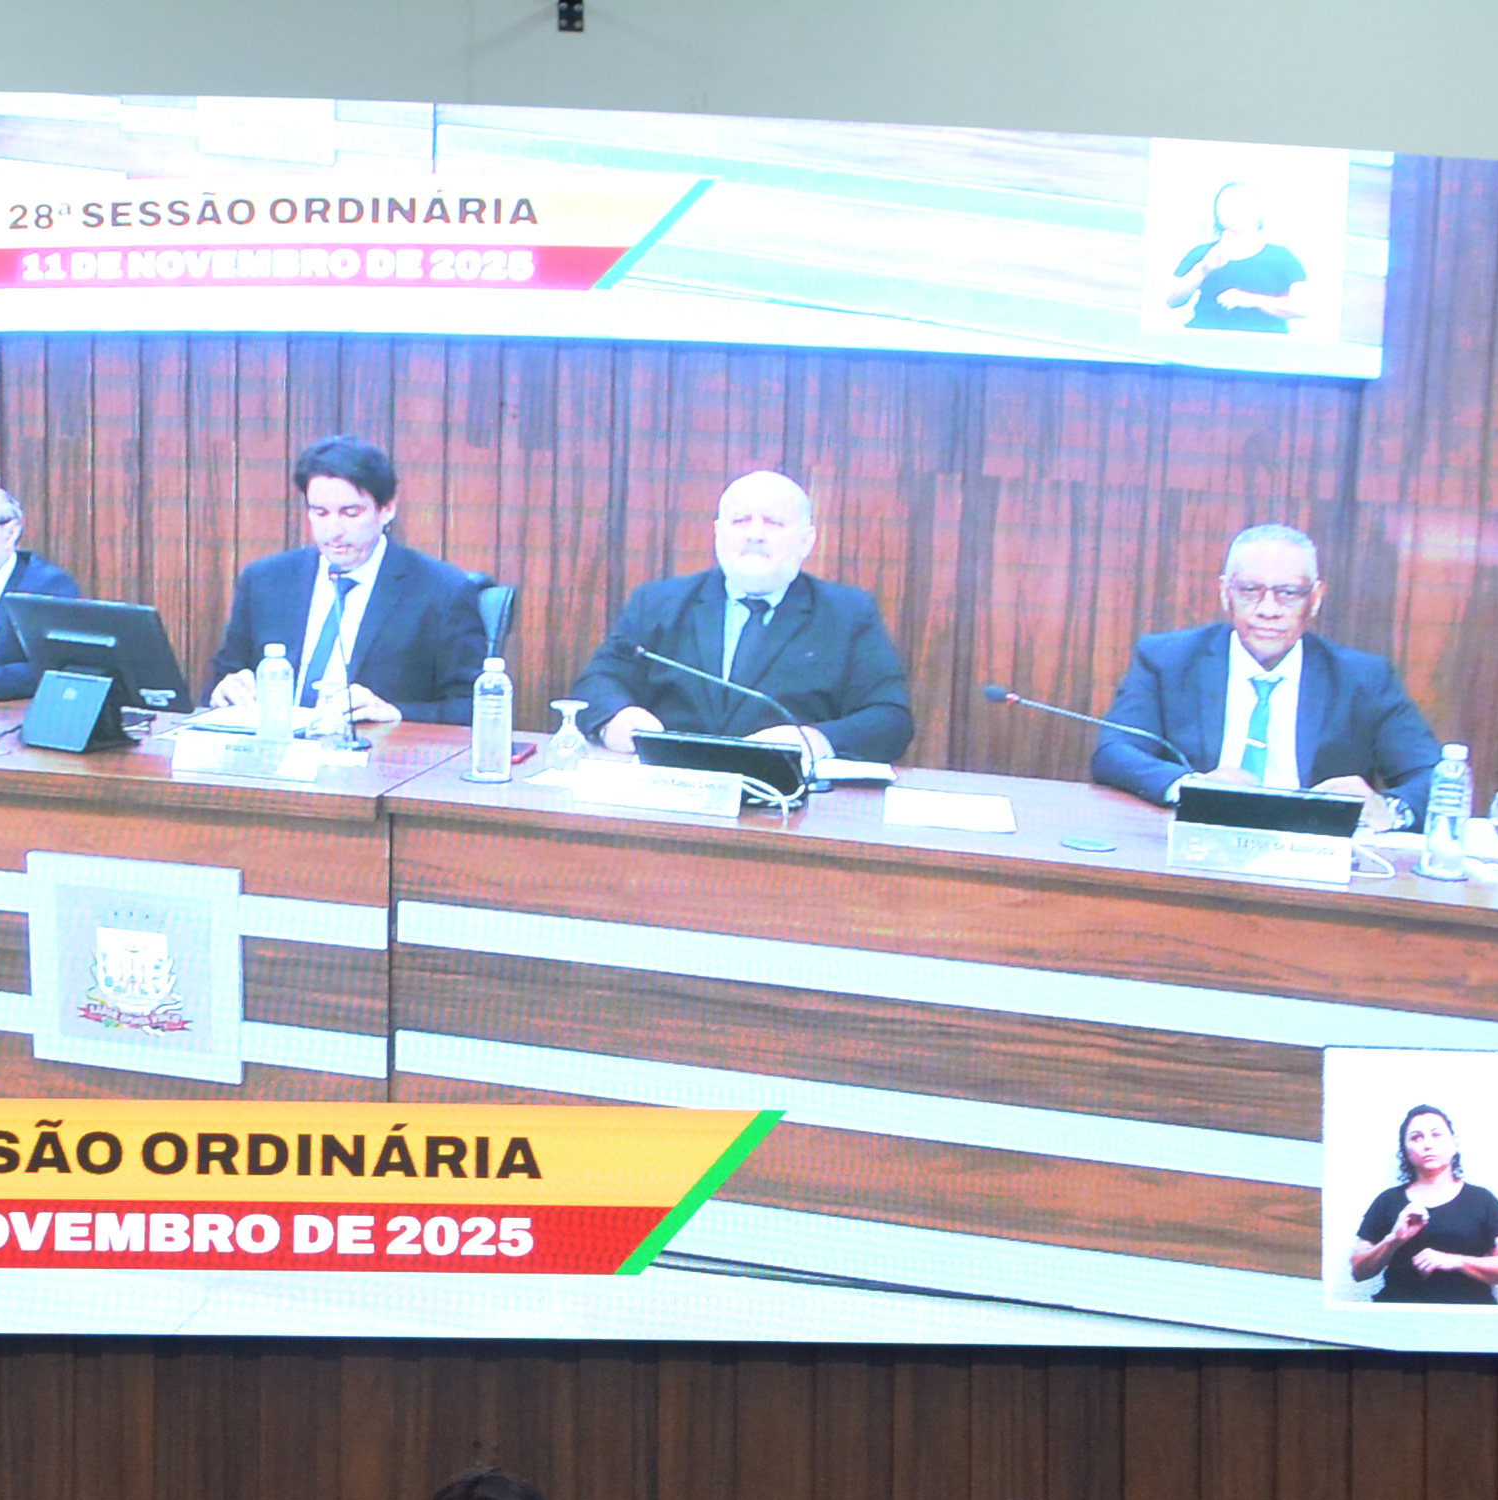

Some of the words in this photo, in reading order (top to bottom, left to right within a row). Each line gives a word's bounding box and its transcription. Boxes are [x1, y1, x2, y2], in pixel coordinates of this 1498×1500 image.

[81, 192, 256, 228] SESSÃO
[268, 189, 539, 226] ORDINÁRIA
[21, 251, 67, 281] 11
[70, 251, 122, 280] DE
[127, 249, 361, 280] NOVEMBRO
[366, 249, 424, 280] DE
[429, 249, 536, 282] 2025
[141, 1123, 543, 1179] ORDINÁRIA
[293, 1214, 375, 1255] DE
[386, 1215, 534, 1257] 2025
